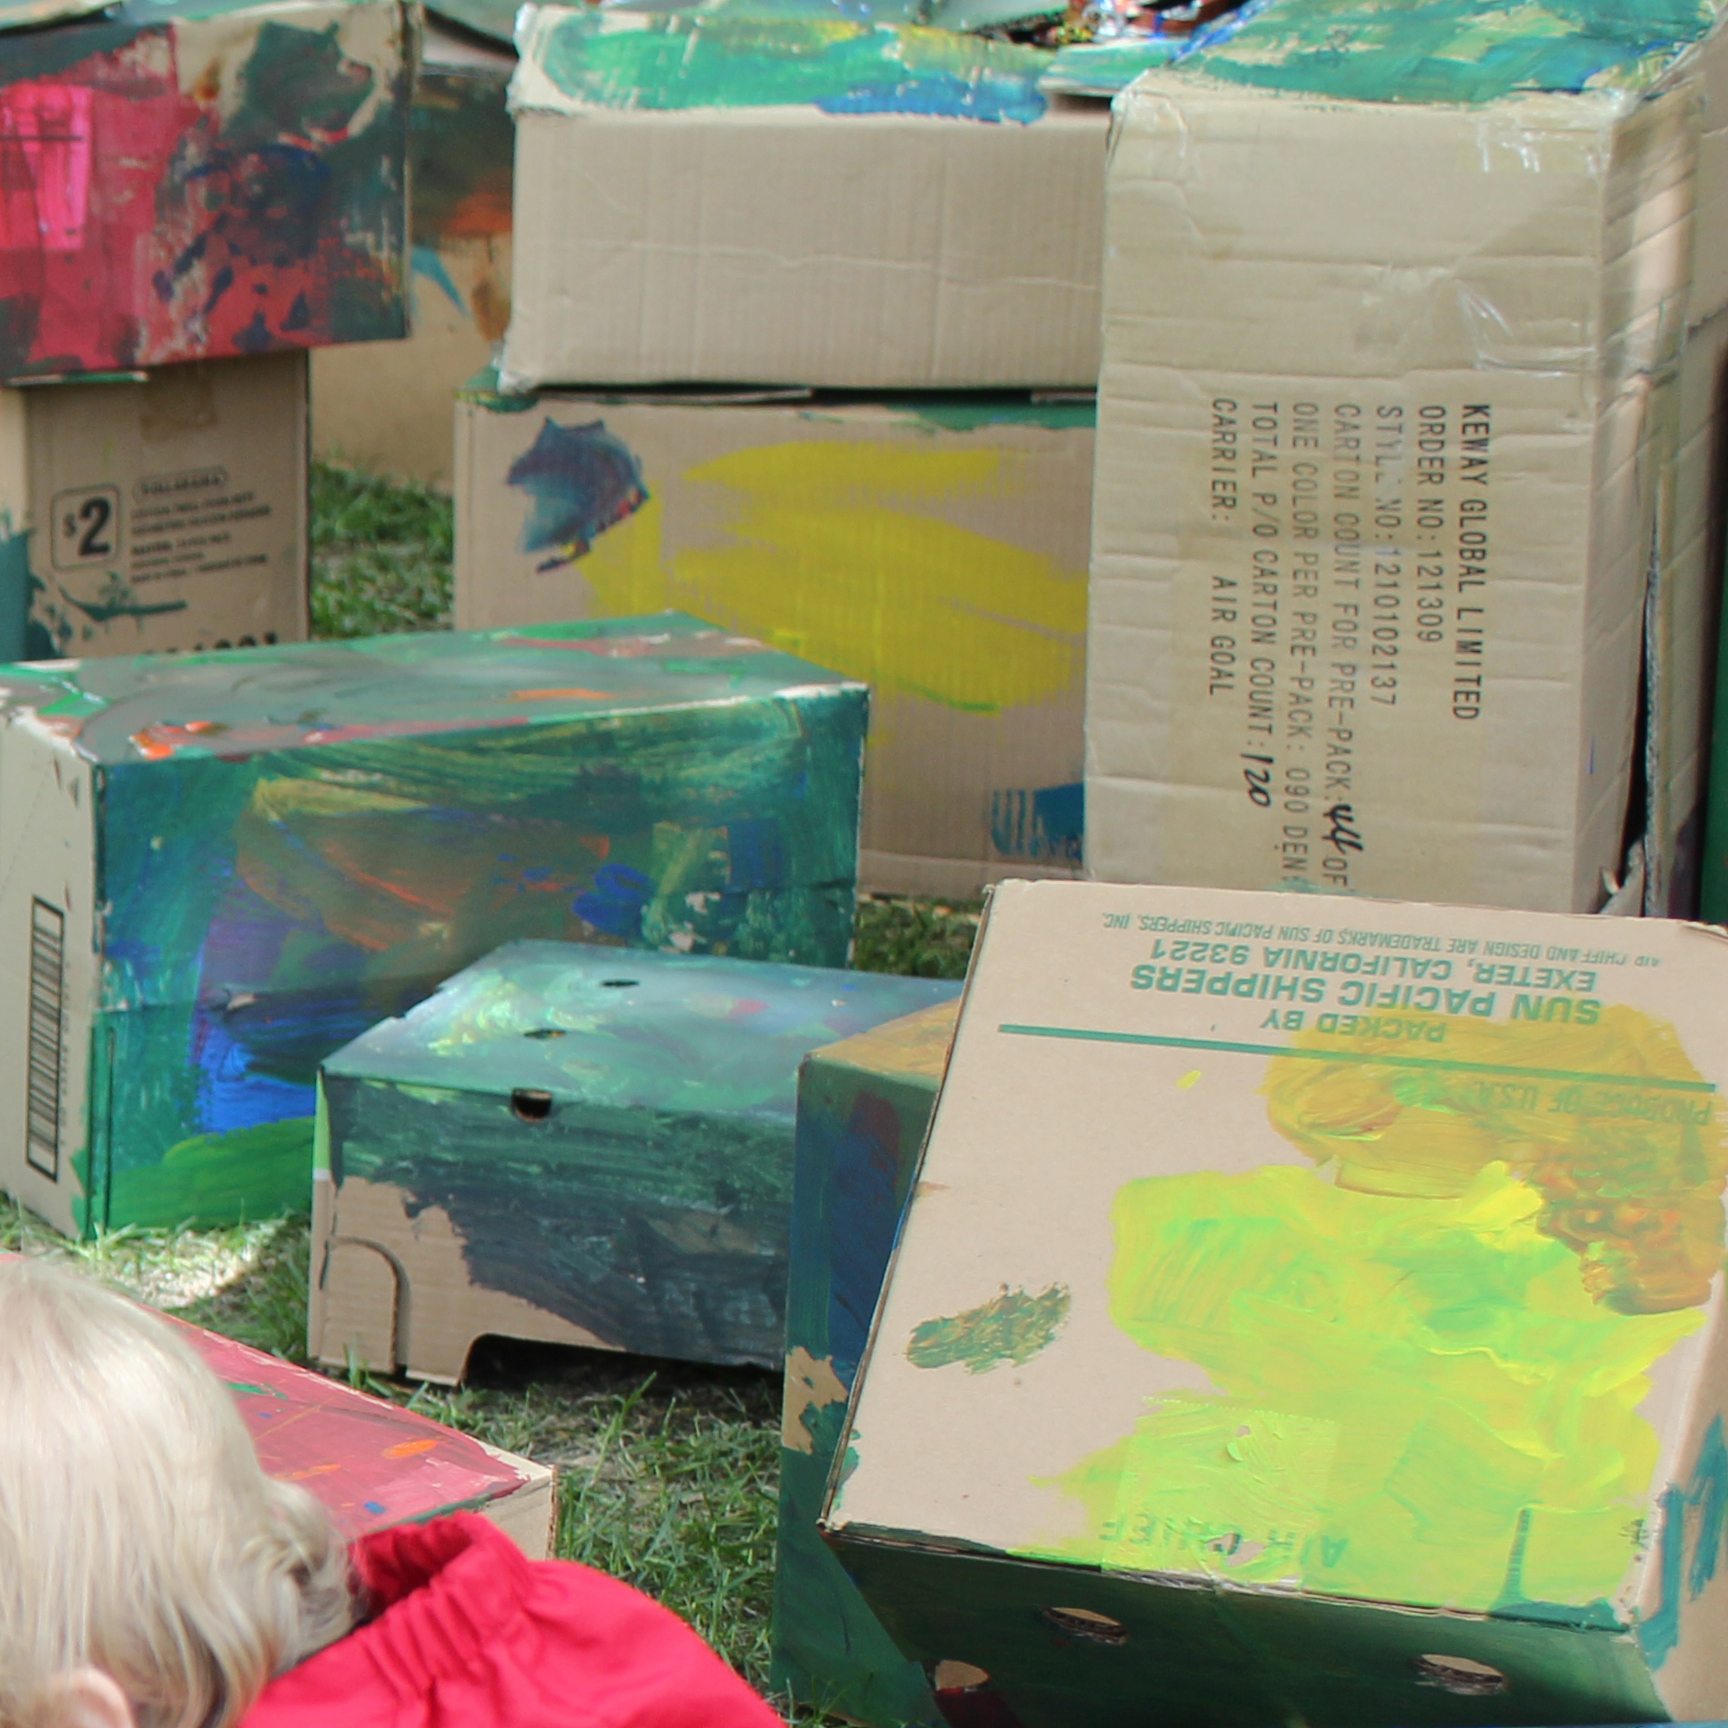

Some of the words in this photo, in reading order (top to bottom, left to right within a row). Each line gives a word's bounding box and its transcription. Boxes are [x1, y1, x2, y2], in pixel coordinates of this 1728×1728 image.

[1251, 401, 1279, 478] TOTAL
[1291, 401, 1319, 448] ONE
[1417, 405, 1446, 485] ORDER
[1459, 404, 1490, 485] KEWAY
[1210, 398, 1237, 521] CARRIER:
[1333, 403, 1361, 500] CARTON
[1290, 462, 1318, 540] COLOR
[62, 496, 112, 557] $2
[1457, 499, 1488, 593] GLOBAL
[1332, 512, 1360, 589] COUNT
[1249, 550, 1278, 645] CARTON
[1289, 552, 1316, 597] PER
[1210, 575, 1237, 622] AIR
[1332, 603, 1357, 649] FOR
[1208, 635, 1236, 696] GOAL
[1285, 612, 1316, 751] PRE-PACK:
[1452, 608, 1483, 721] LIMITED
[1246, 657, 1275, 747] COUNT:
[1324, 662, 1356, 802] PRE-PACK:
[1240, 753, 1274, 809] 120
[1283, 767, 1310, 814] 090
[1101, 912, 1131, 929] INC.
[1279, 926, 1309, 943] SUN
[1313, 929, 1333, 944] OF
[1337, 928, 1441, 952] TRADEMARKS
[1149, 938, 1250, 966] 93221
[1263, 946, 1452, 982] CALIFORNIA
[1446, 937, 1478, 953] ARE
[1483, 939, 1541, 958] DESIGN
[1547, 946, 1581, 963] AND
[1129, 963, 1325, 1004] SHIPPERS
[1337, 979, 1497, 1017] PACIFIC
[1465, 958, 1597, 992] EXETER,
[1259, 1008, 1304, 1031] BY
[1315, 1011, 1447, 1043] PACKED
[1509, 993, 1601, 1026] SUN
